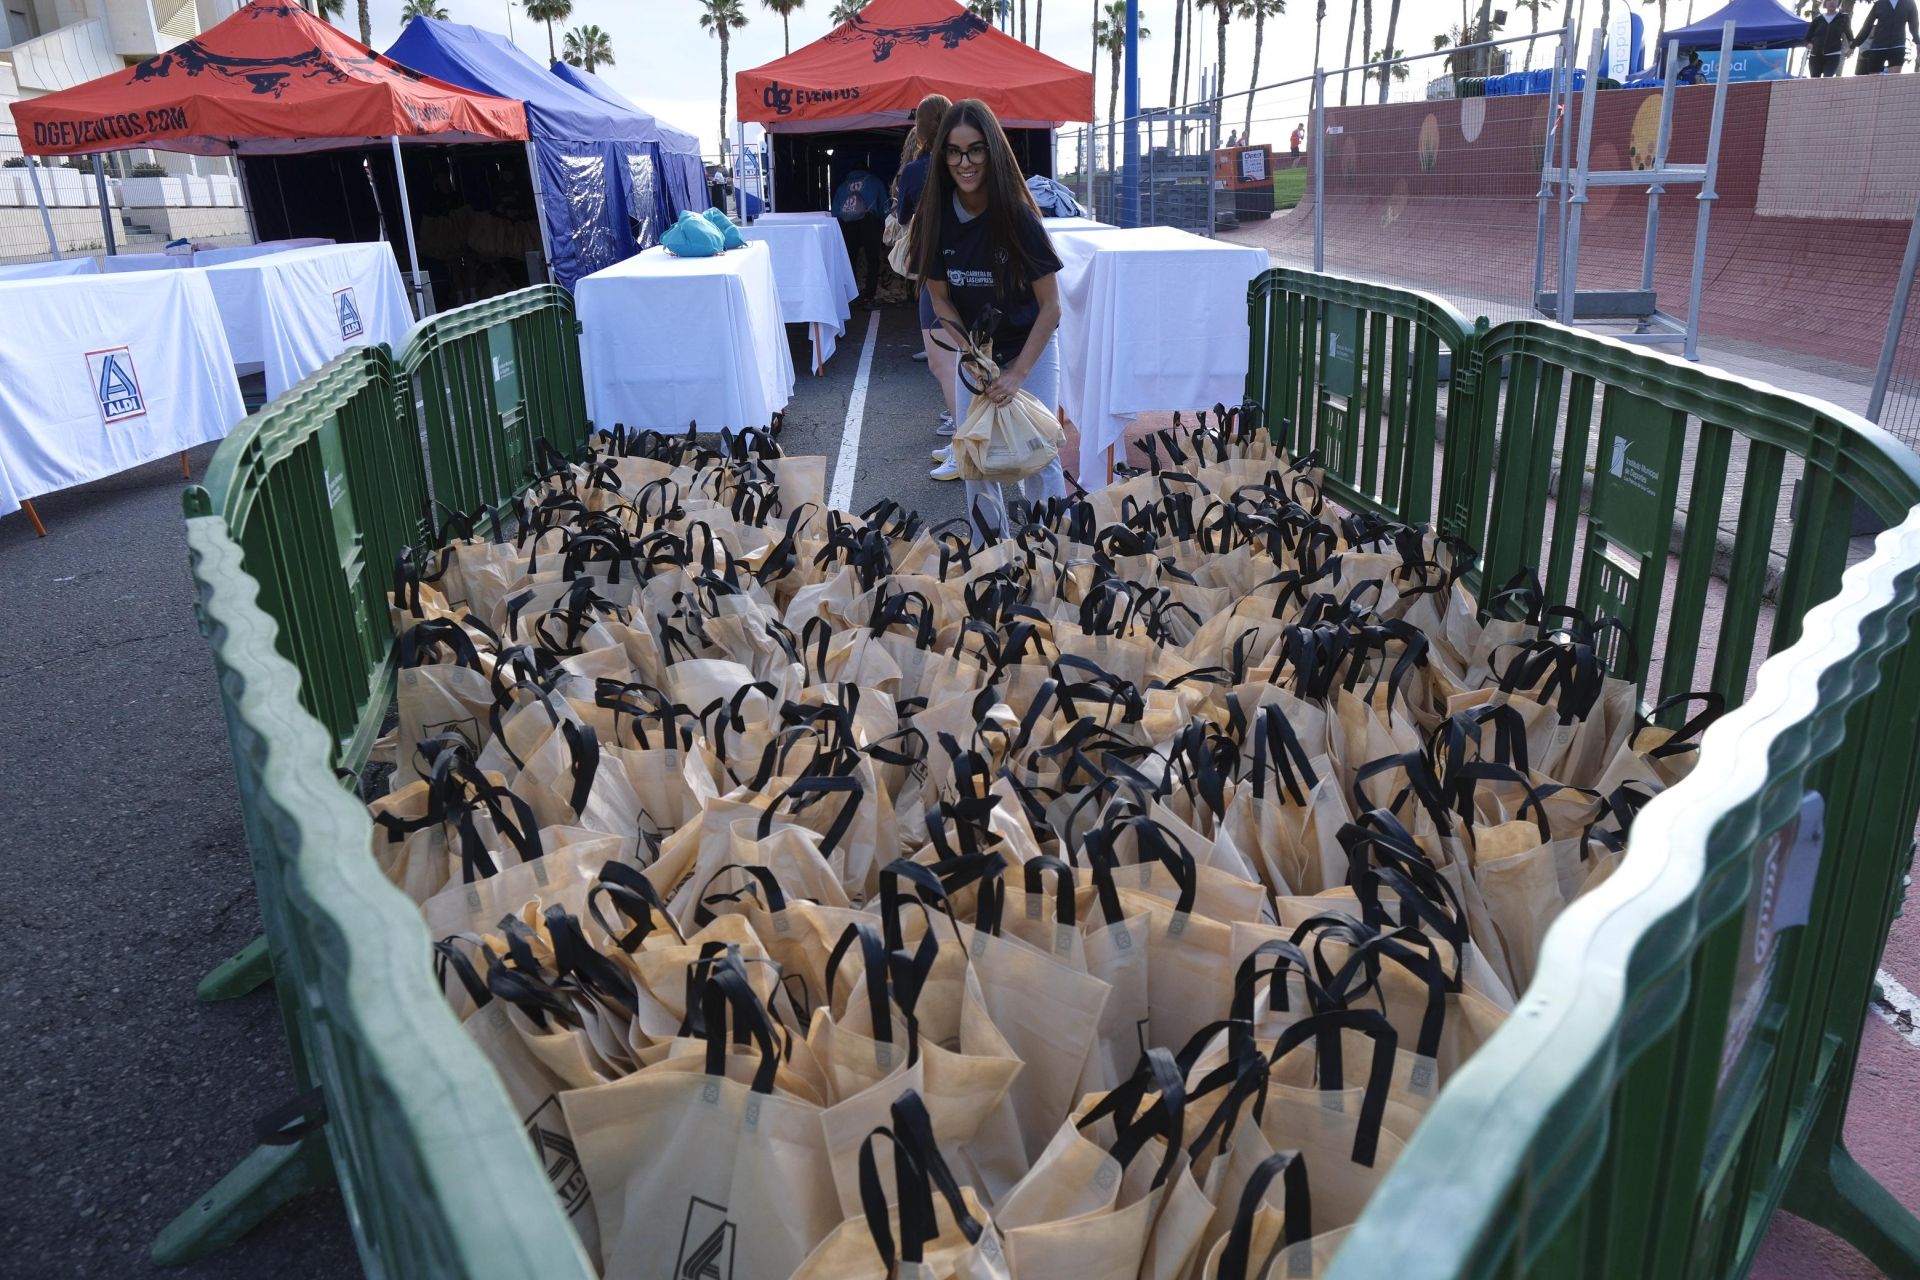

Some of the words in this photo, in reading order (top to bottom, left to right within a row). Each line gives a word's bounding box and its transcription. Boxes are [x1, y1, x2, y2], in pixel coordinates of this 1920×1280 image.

[763, 81, 792, 115] dg
[34, 106, 188, 147] DGEVENTOS.COM
[344, 322, 360, 335] ALDI
[108, 398, 138, 416] ALDI
